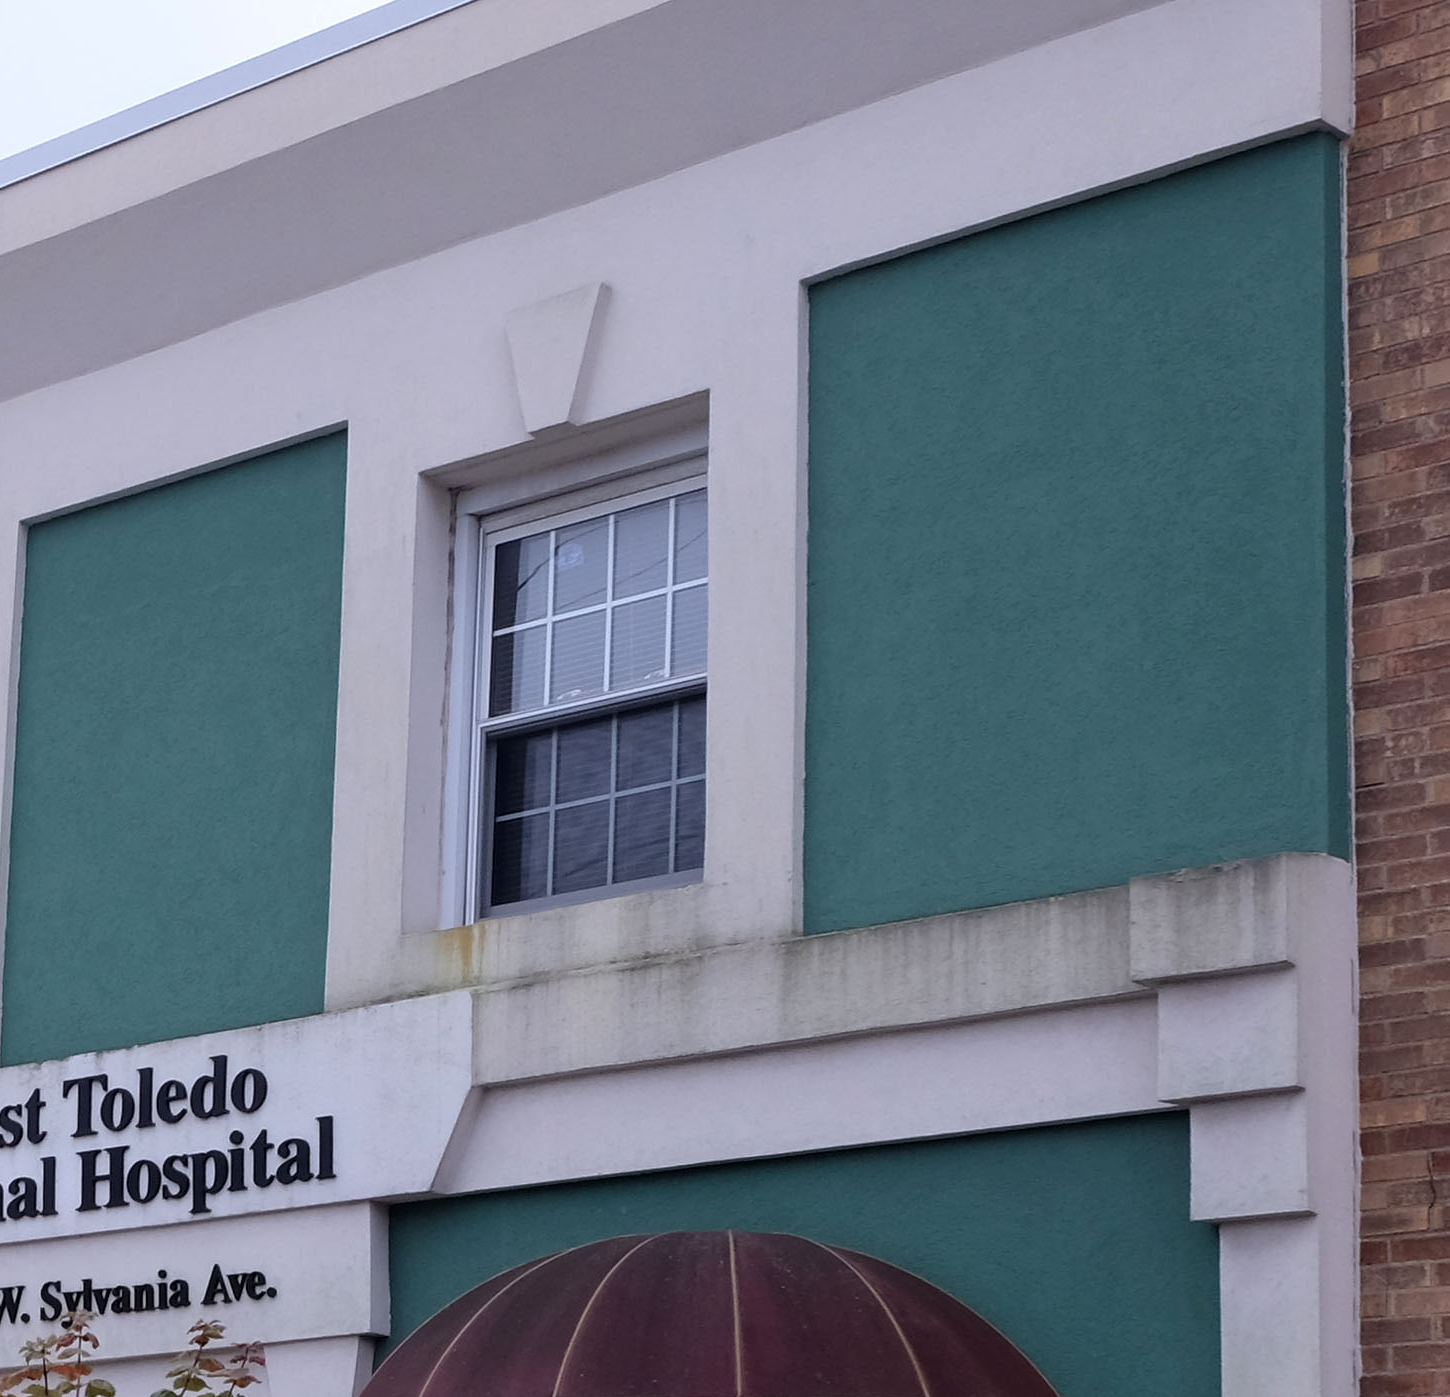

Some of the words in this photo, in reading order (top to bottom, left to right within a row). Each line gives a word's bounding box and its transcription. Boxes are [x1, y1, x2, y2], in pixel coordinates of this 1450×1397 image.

[62, 1054, 268, 1138] Toledo
[76, 1115, 336, 1214] Hospital
[40, 1269, 190, 1328] Sylvania
[203, 1263, 279, 1305] Ave.
